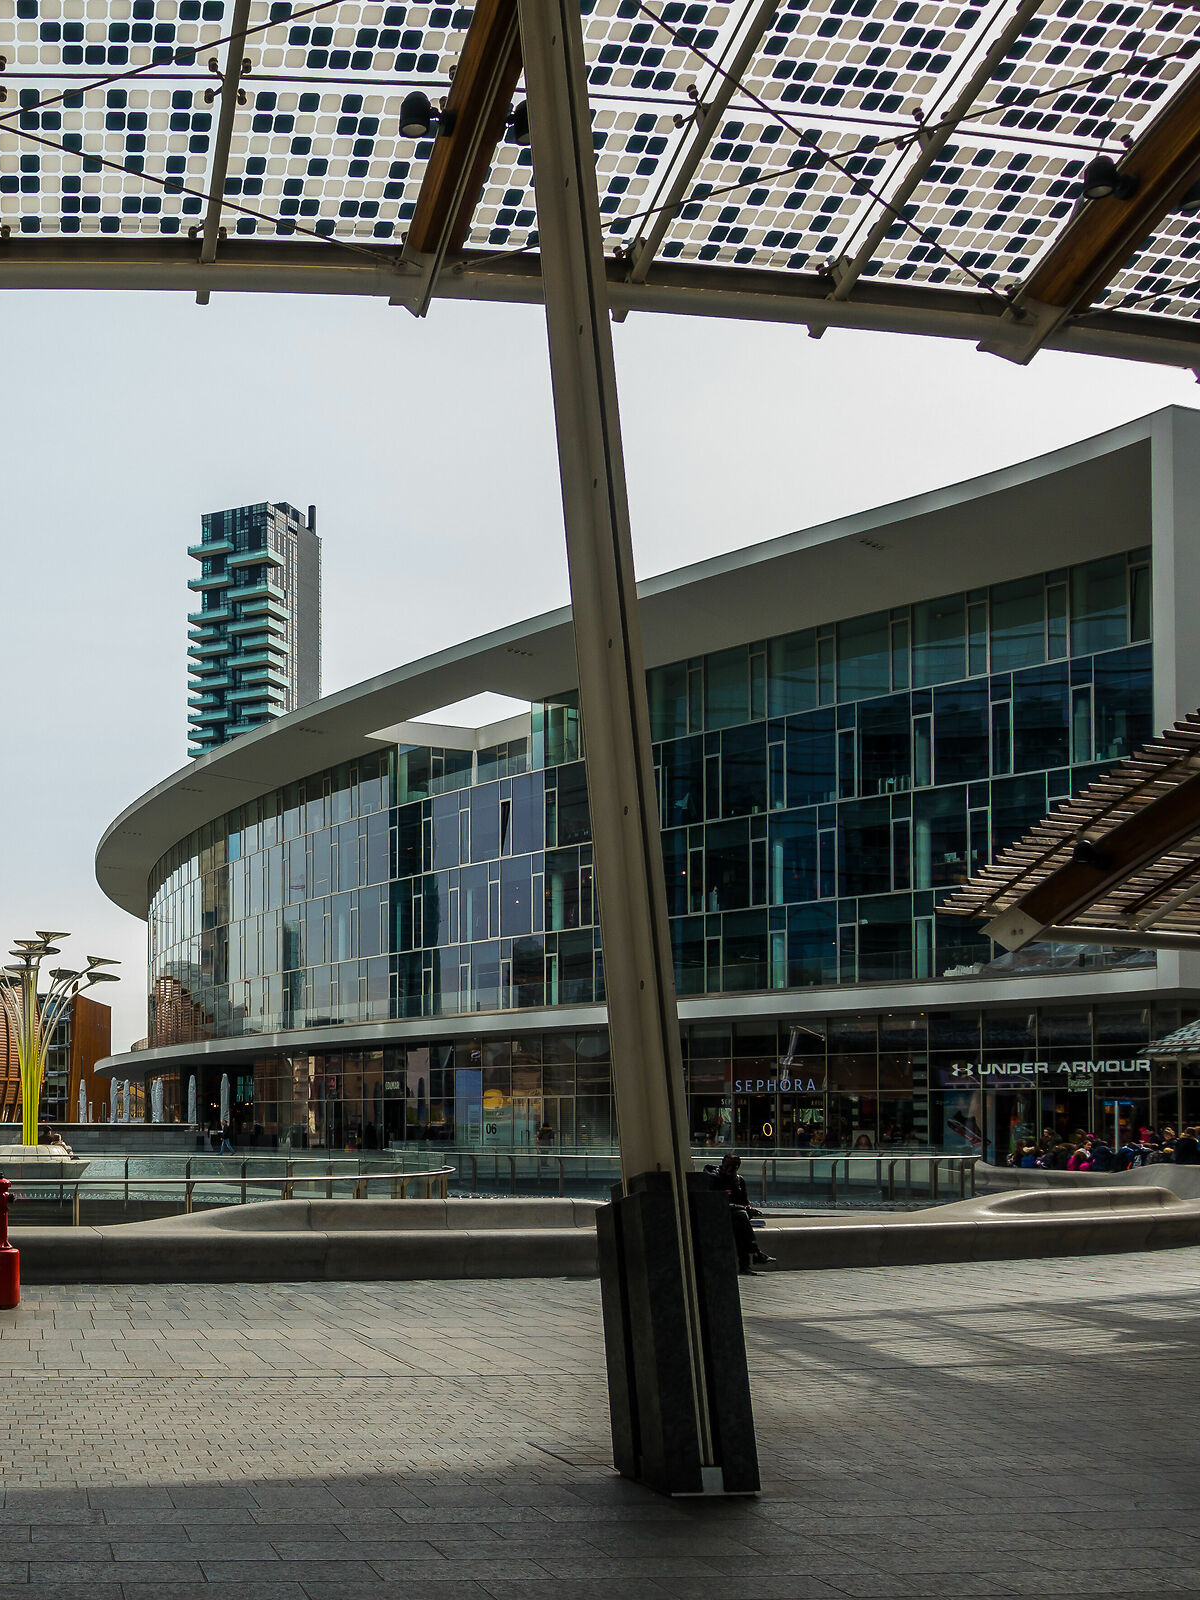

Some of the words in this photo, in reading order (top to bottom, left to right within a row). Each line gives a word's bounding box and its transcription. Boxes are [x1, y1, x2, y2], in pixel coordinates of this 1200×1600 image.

[977, 1061, 1049, 1075] UNDER
[1056, 1059, 1151, 1073] ARMOUR
[735, 1078, 817, 1093] SEPHORA
[486, 1123, 497, 1135] 06
